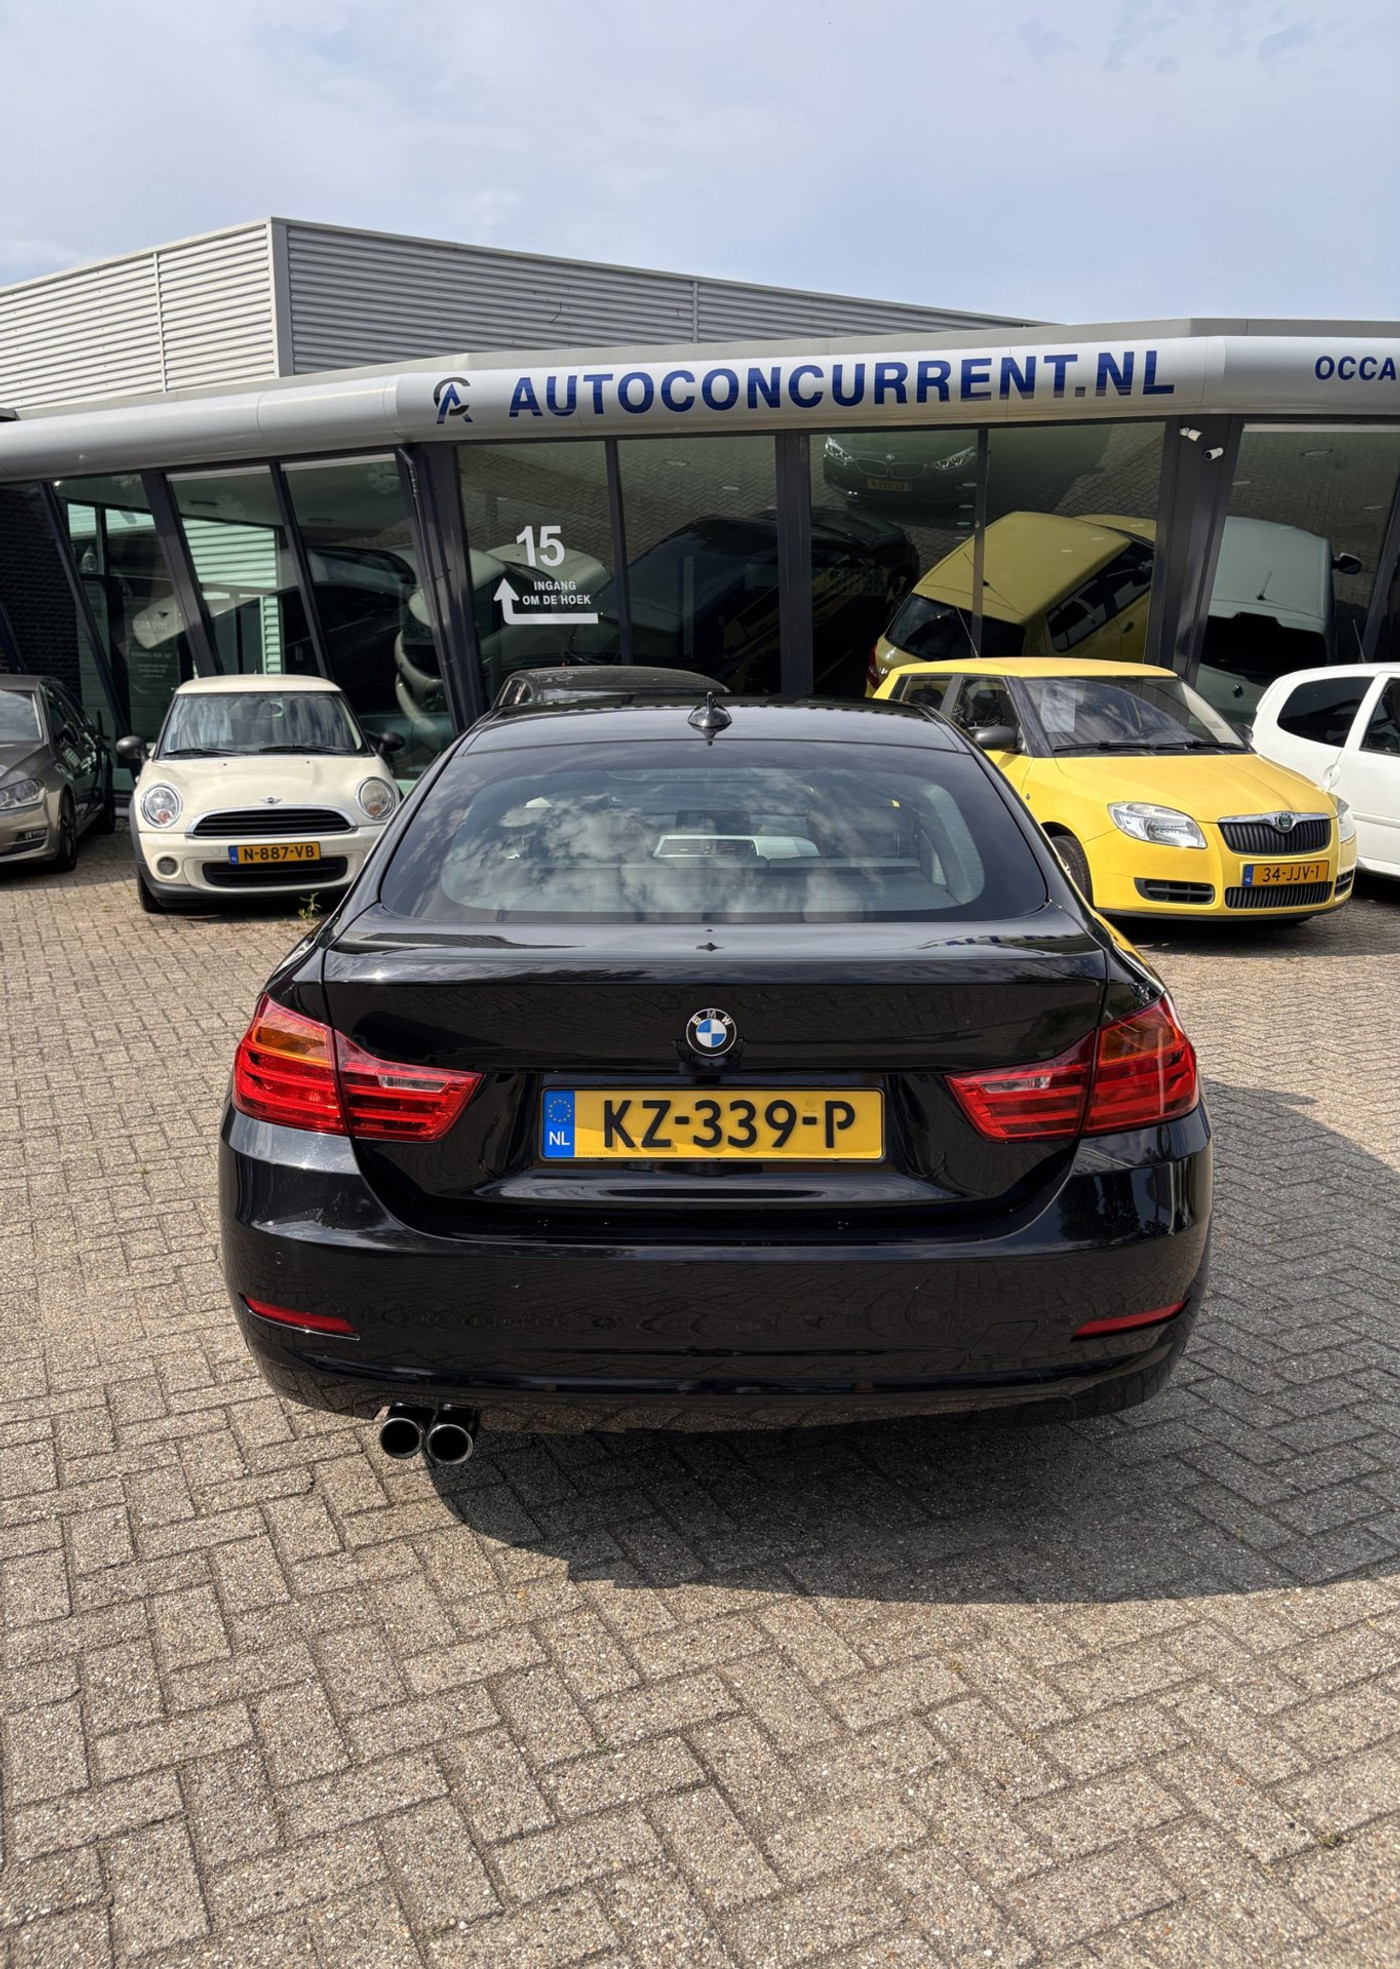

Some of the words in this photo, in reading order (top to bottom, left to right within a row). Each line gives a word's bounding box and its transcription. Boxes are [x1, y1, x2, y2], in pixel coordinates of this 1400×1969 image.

[1314, 355, 1400, 381] OCCA
[508, 350, 1175, 418] AUTOCONCURRENT.NL
[516, 525, 565, 567] 15
[533, 580, 577, 591] INGANG
[522, 595, 540, 605] OM
[543, 595, 558, 605] DE
[560, 594, 592, 605] HOEK
[243, 845, 315, 861] N-887-VB
[1262, 865, 1320, 882] 34-JJV-1
[549, 1130, 571, 1146] NL
[603, 1099, 855, 1149] KZ-339-P
